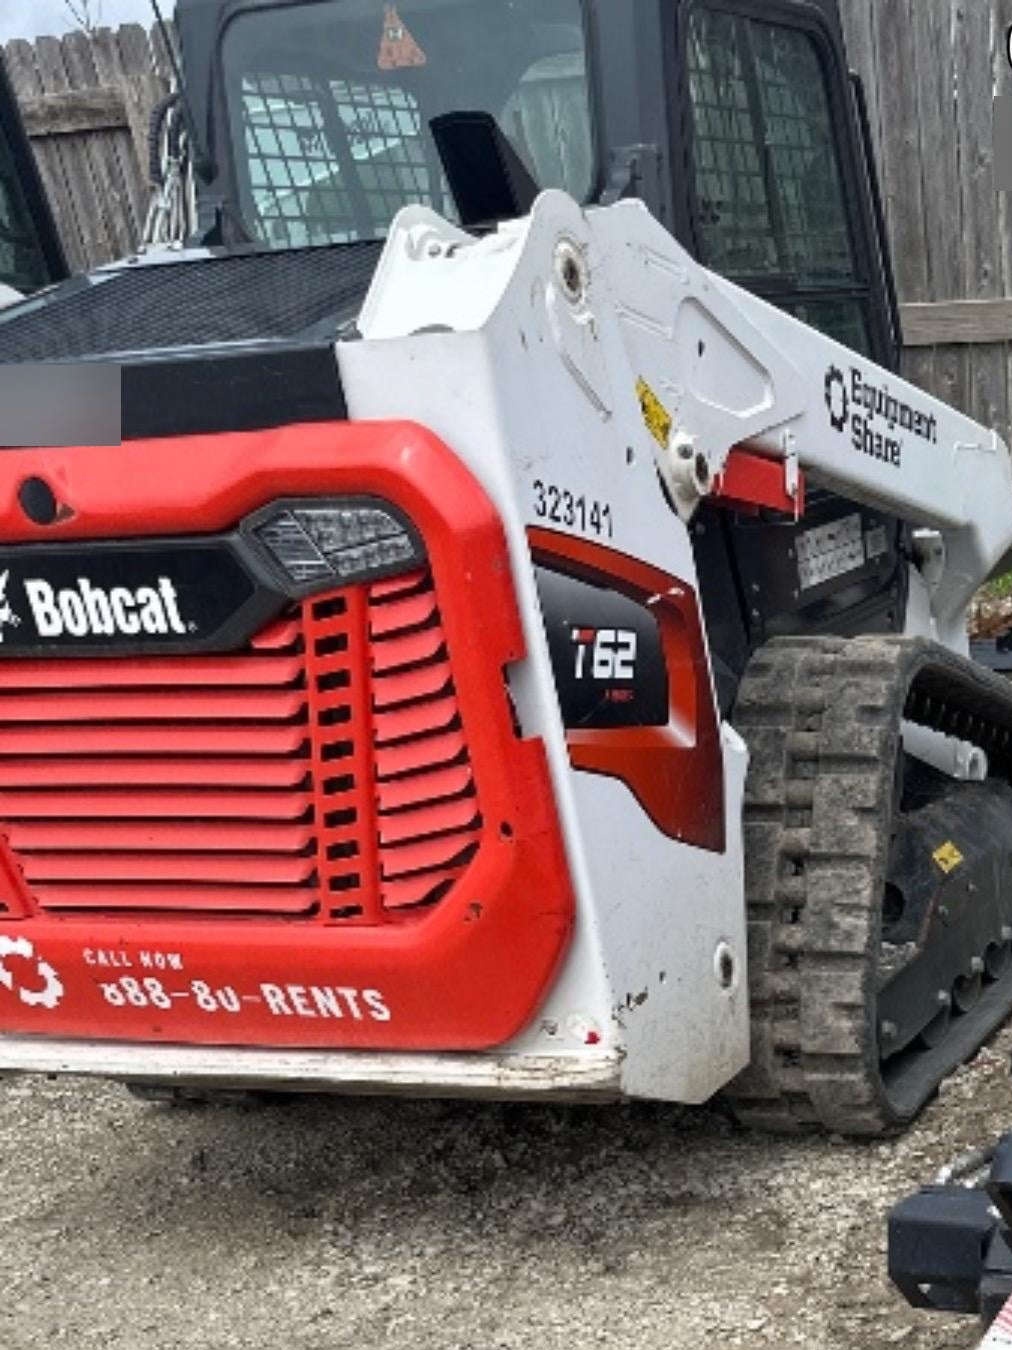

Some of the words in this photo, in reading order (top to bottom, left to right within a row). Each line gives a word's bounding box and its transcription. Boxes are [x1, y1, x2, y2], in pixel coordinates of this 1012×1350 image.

[850, 366, 937, 444] Equipment
[851, 413, 901, 467] Share
[533, 479, 613, 538] 323141
[24, 577, 187, 637] Bobcat
[571, 629, 637, 679] T62
[82, 947, 132, 967] CALL
[139, 950, 184, 970] NOW
